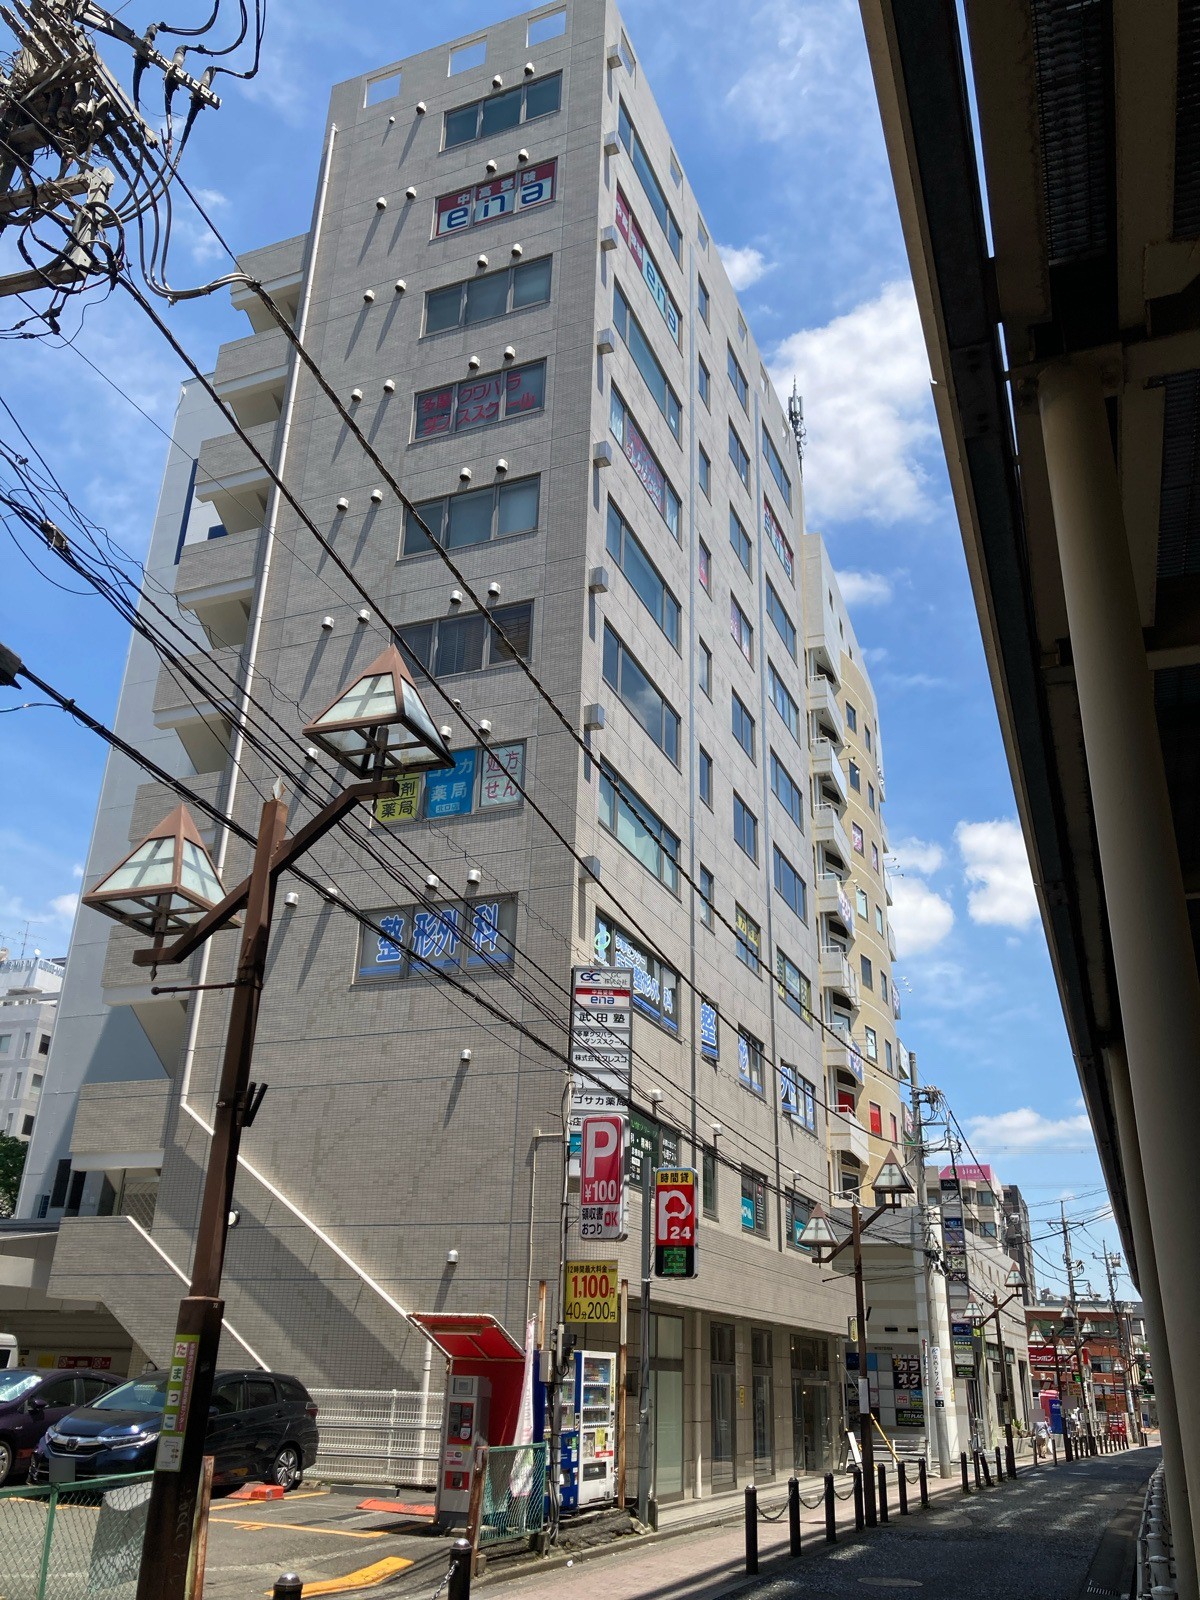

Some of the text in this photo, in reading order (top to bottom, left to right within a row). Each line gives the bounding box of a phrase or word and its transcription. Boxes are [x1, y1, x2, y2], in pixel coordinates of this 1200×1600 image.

[447, 182, 544, 229] ena
[486, 750, 519, 773] 処方
[431, 782, 467, 802] 薬局
[485, 781, 517, 798] せん
[376, 902, 498, 962] 整形外科
[590, 996, 615, 1005] ena
[579, 1012, 625, 1023] 武田塾
[586, 1121, 617, 1178] P
[660, 1173, 689, 1183] 時間貸
[585, 1180, 617, 1202] ¥100
[582, 1207, 603, 1221] 領収書
[604, 1211, 618, 1227] OK
[582, 1223, 603, 1235] おつり
[670, 1226, 691, 1240] 24
[572, 1274, 615, 1299] 1,100円
[566, 1301, 616, 1320] 40分200円
